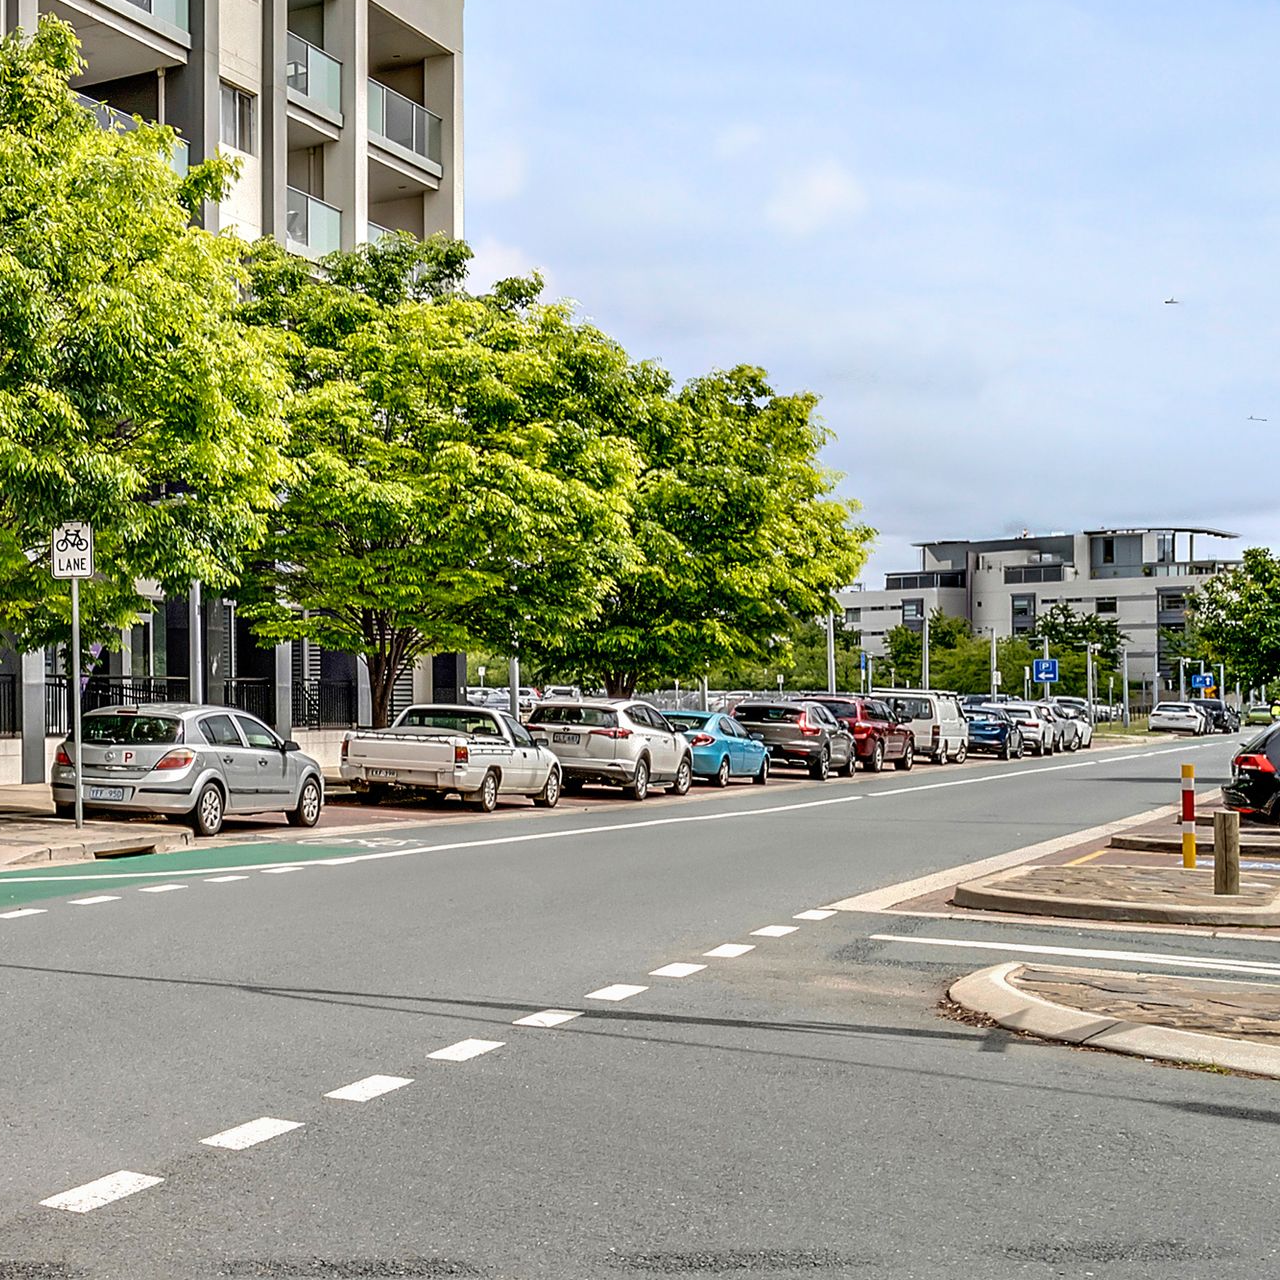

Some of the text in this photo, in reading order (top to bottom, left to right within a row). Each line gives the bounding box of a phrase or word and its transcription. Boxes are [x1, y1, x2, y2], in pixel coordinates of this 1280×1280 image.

[58, 557, 87, 571] LANE
[1042, 662, 1050, 670] P
[124, 752, 133, 763] P
